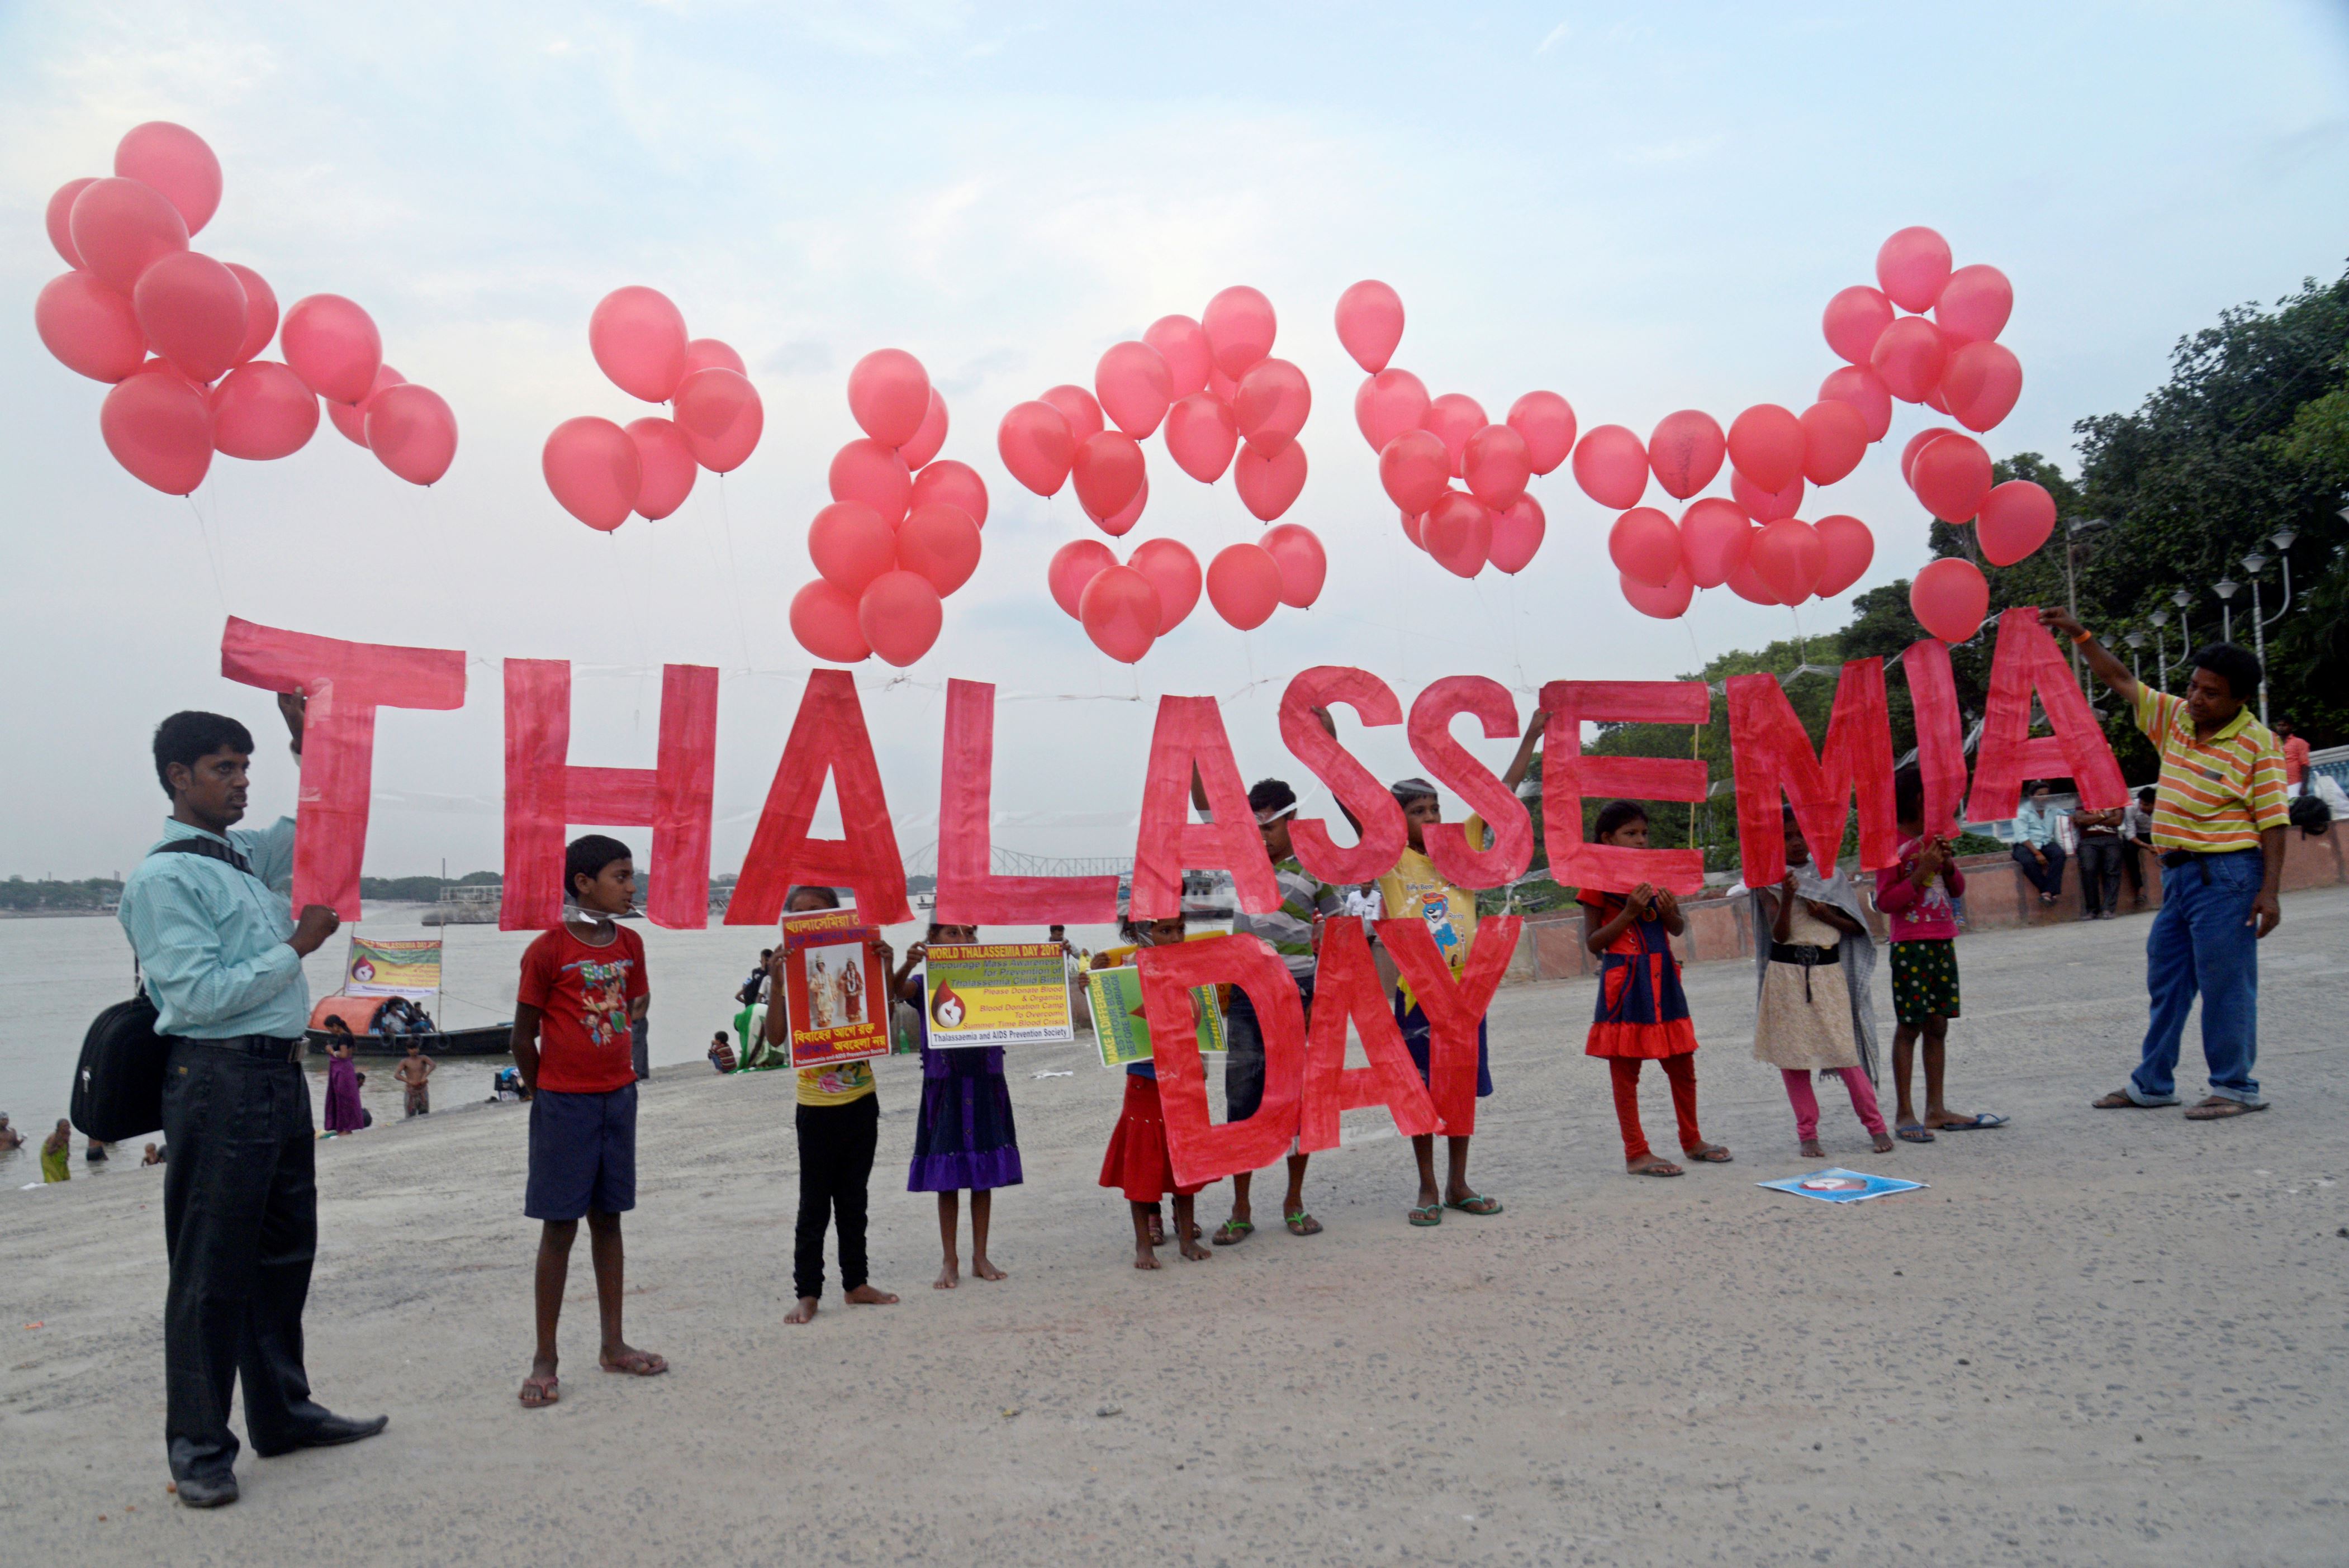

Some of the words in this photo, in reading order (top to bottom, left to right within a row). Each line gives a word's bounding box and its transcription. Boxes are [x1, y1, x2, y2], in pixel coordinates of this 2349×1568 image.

[222, 606, 2132, 930] THALASSEMIA
[928, 947, 959, 959] WORLD
[962, 945, 1021, 958] THALASSEMIA
[1022, 944, 1040, 957] DAY
[1041, 944, 1060, 956] 2017
[929, 961, 980, 970] Encourage
[951, 979, 1010, 988] Thalassemia
[1013, 977, 1037, 986] Child
[1102, 976, 1116, 1006] BLOOD
[1030, 994, 1064, 1003] Organize
[1090, 974, 1111, 1028] DIFFERENCE
[1111, 974, 1127, 1018] MARRIAGE
[1109, 1008, 1121, 1032] YOUR
[1208, 1009, 1223, 1049] CHILD
[794, 1030, 832, 1045] বিবাহের
[833, 1026, 856, 1038] আগে
[858, 1023, 875, 1035] রক্ত
[833, 1037, 870, 1051] অবহেলা
[933, 1032, 977, 1043] Thalassaemia
[979, 1031, 990, 1040] and
[993, 1030, 1007, 1039] AIDS
[1009, 1029, 1042, 1038] Prevention
[1043, 1028, 1067, 1038] Society
[1114, 1035, 1126, 1056] TEST
[1122, 1020, 1137, 1056] BEFORE
[1103, 1037, 1119, 1063] MAKE
[1136, 915, 1524, 1187] DAY
